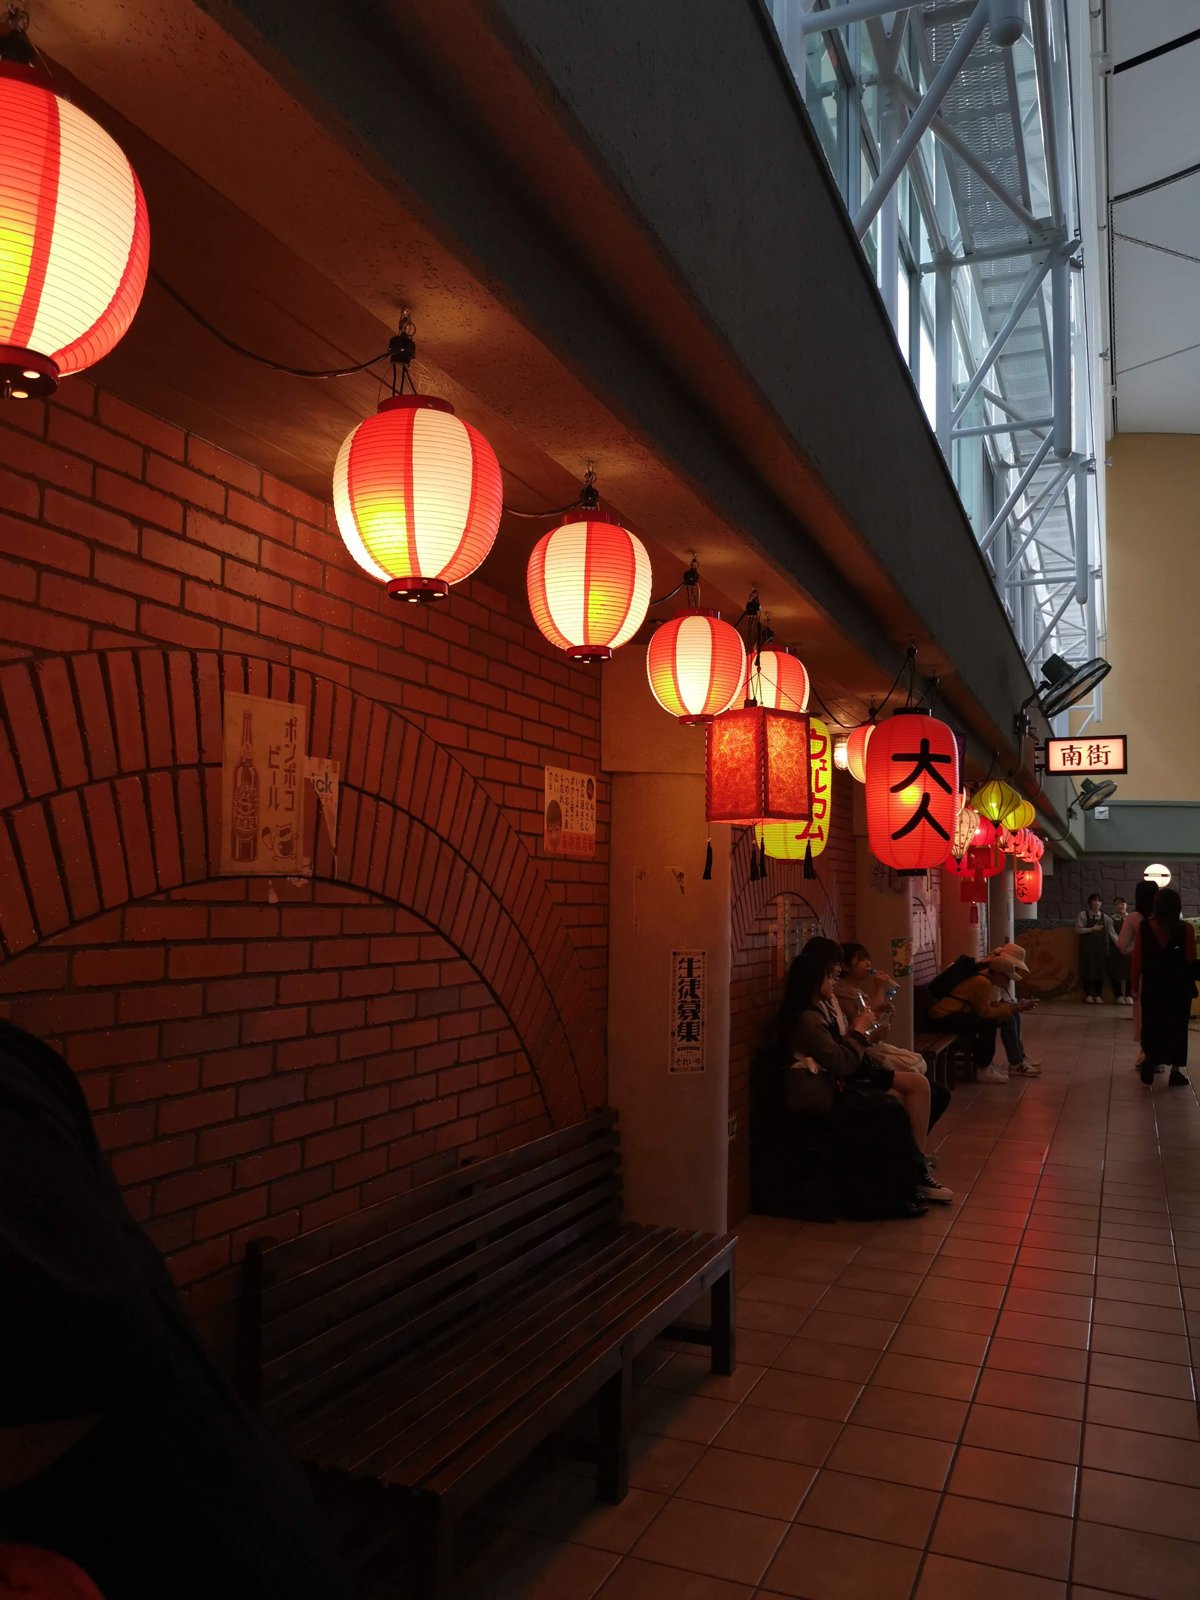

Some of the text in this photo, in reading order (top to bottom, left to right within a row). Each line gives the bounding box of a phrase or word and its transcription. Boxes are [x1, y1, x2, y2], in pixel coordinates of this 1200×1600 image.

[268, 745, 281, 811] ビール
[284, 716, 297, 812] ポンポコ
[889, 738, 952, 842] 大人
[1060, 744, 1112, 767] 南街
[678, 957, 701, 1042] 生徒募集
